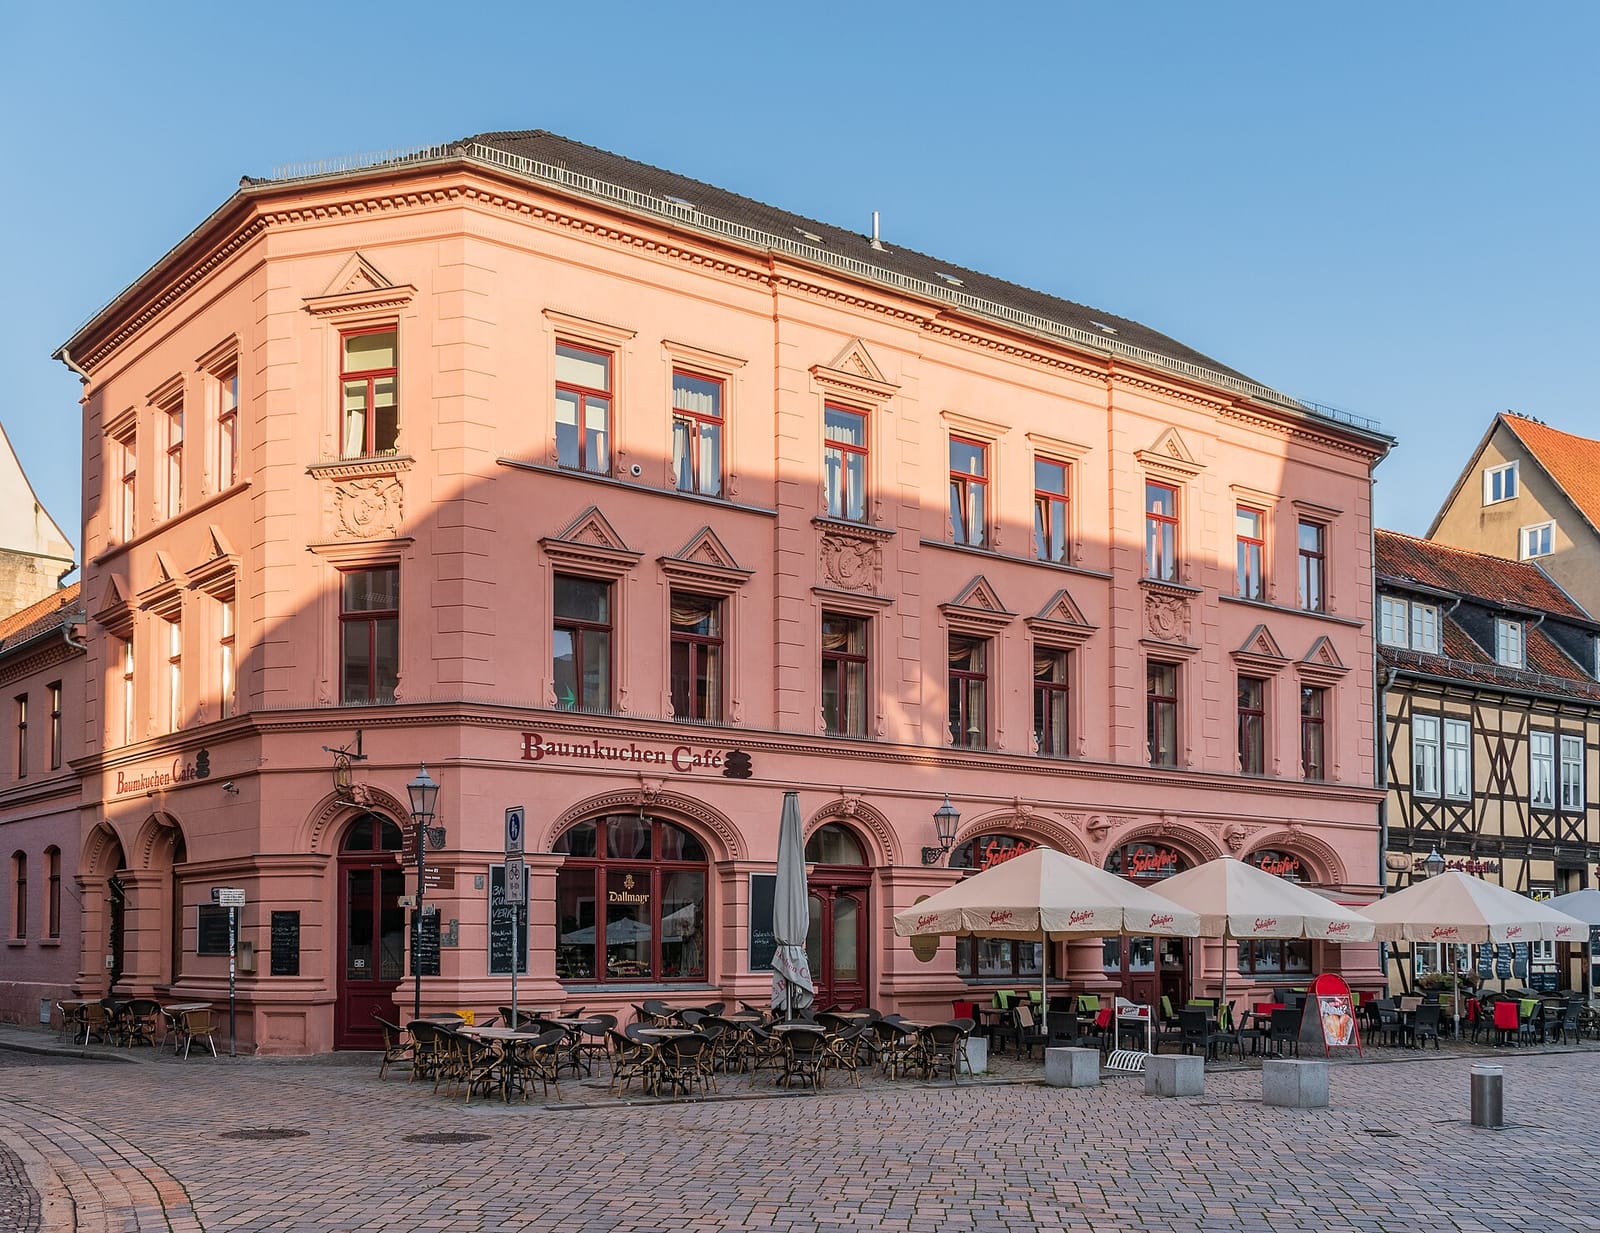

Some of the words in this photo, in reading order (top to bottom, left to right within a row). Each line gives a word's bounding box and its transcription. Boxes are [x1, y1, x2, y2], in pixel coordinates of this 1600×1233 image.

[521, 732, 667, 765] Baumkuchen
[672, 745, 722, 773] Café
[117, 771, 170, 795] Baumkuchen
[609, 891, 650, 904] Dallmayr
